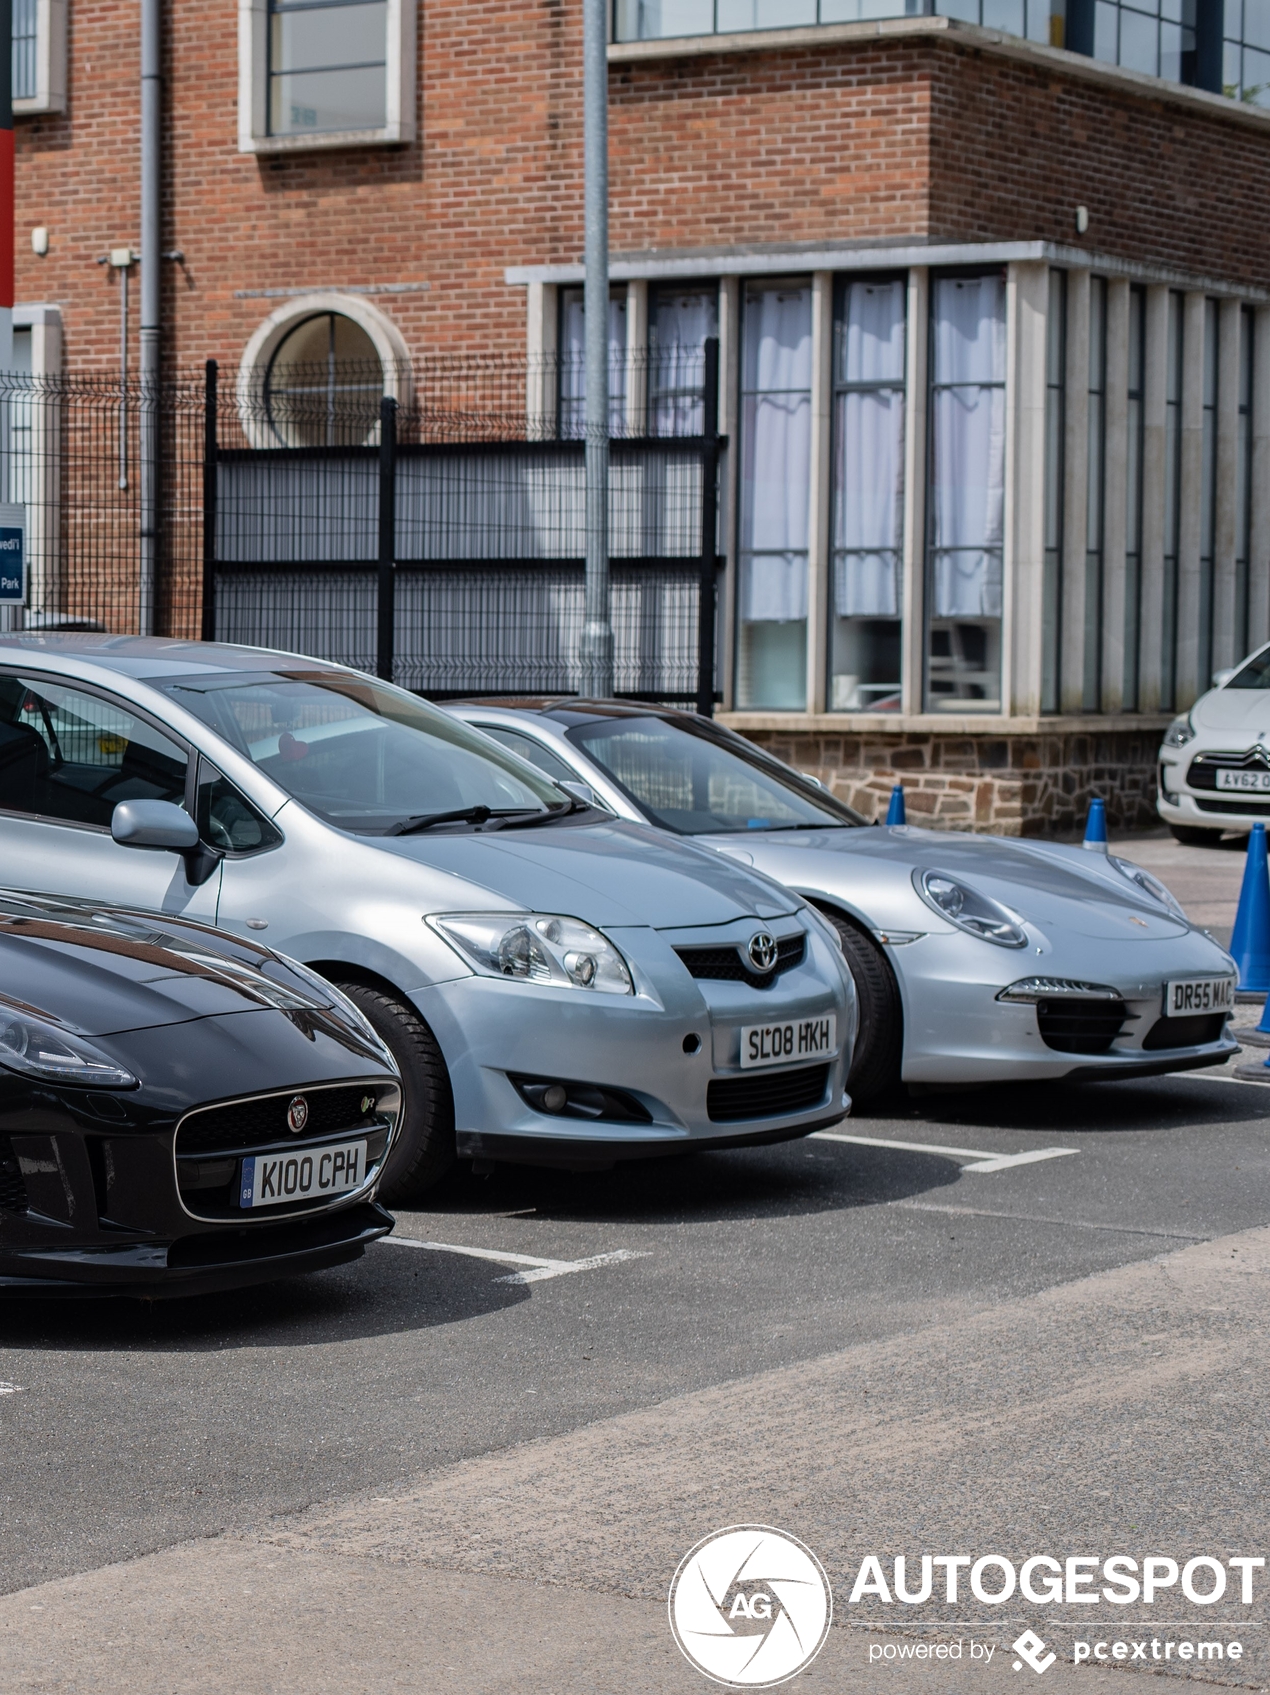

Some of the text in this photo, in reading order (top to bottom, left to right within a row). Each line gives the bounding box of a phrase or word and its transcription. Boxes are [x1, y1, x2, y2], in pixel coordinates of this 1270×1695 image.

[1, 577, 20, 590] Park
[1174, 980, 1232, 1010] DR55 MAC
[748, 1019, 830, 1061] SL08 HKH
[261, 1148, 359, 1199] K100 CPH
[242, 1188, 252, 1200] GB
